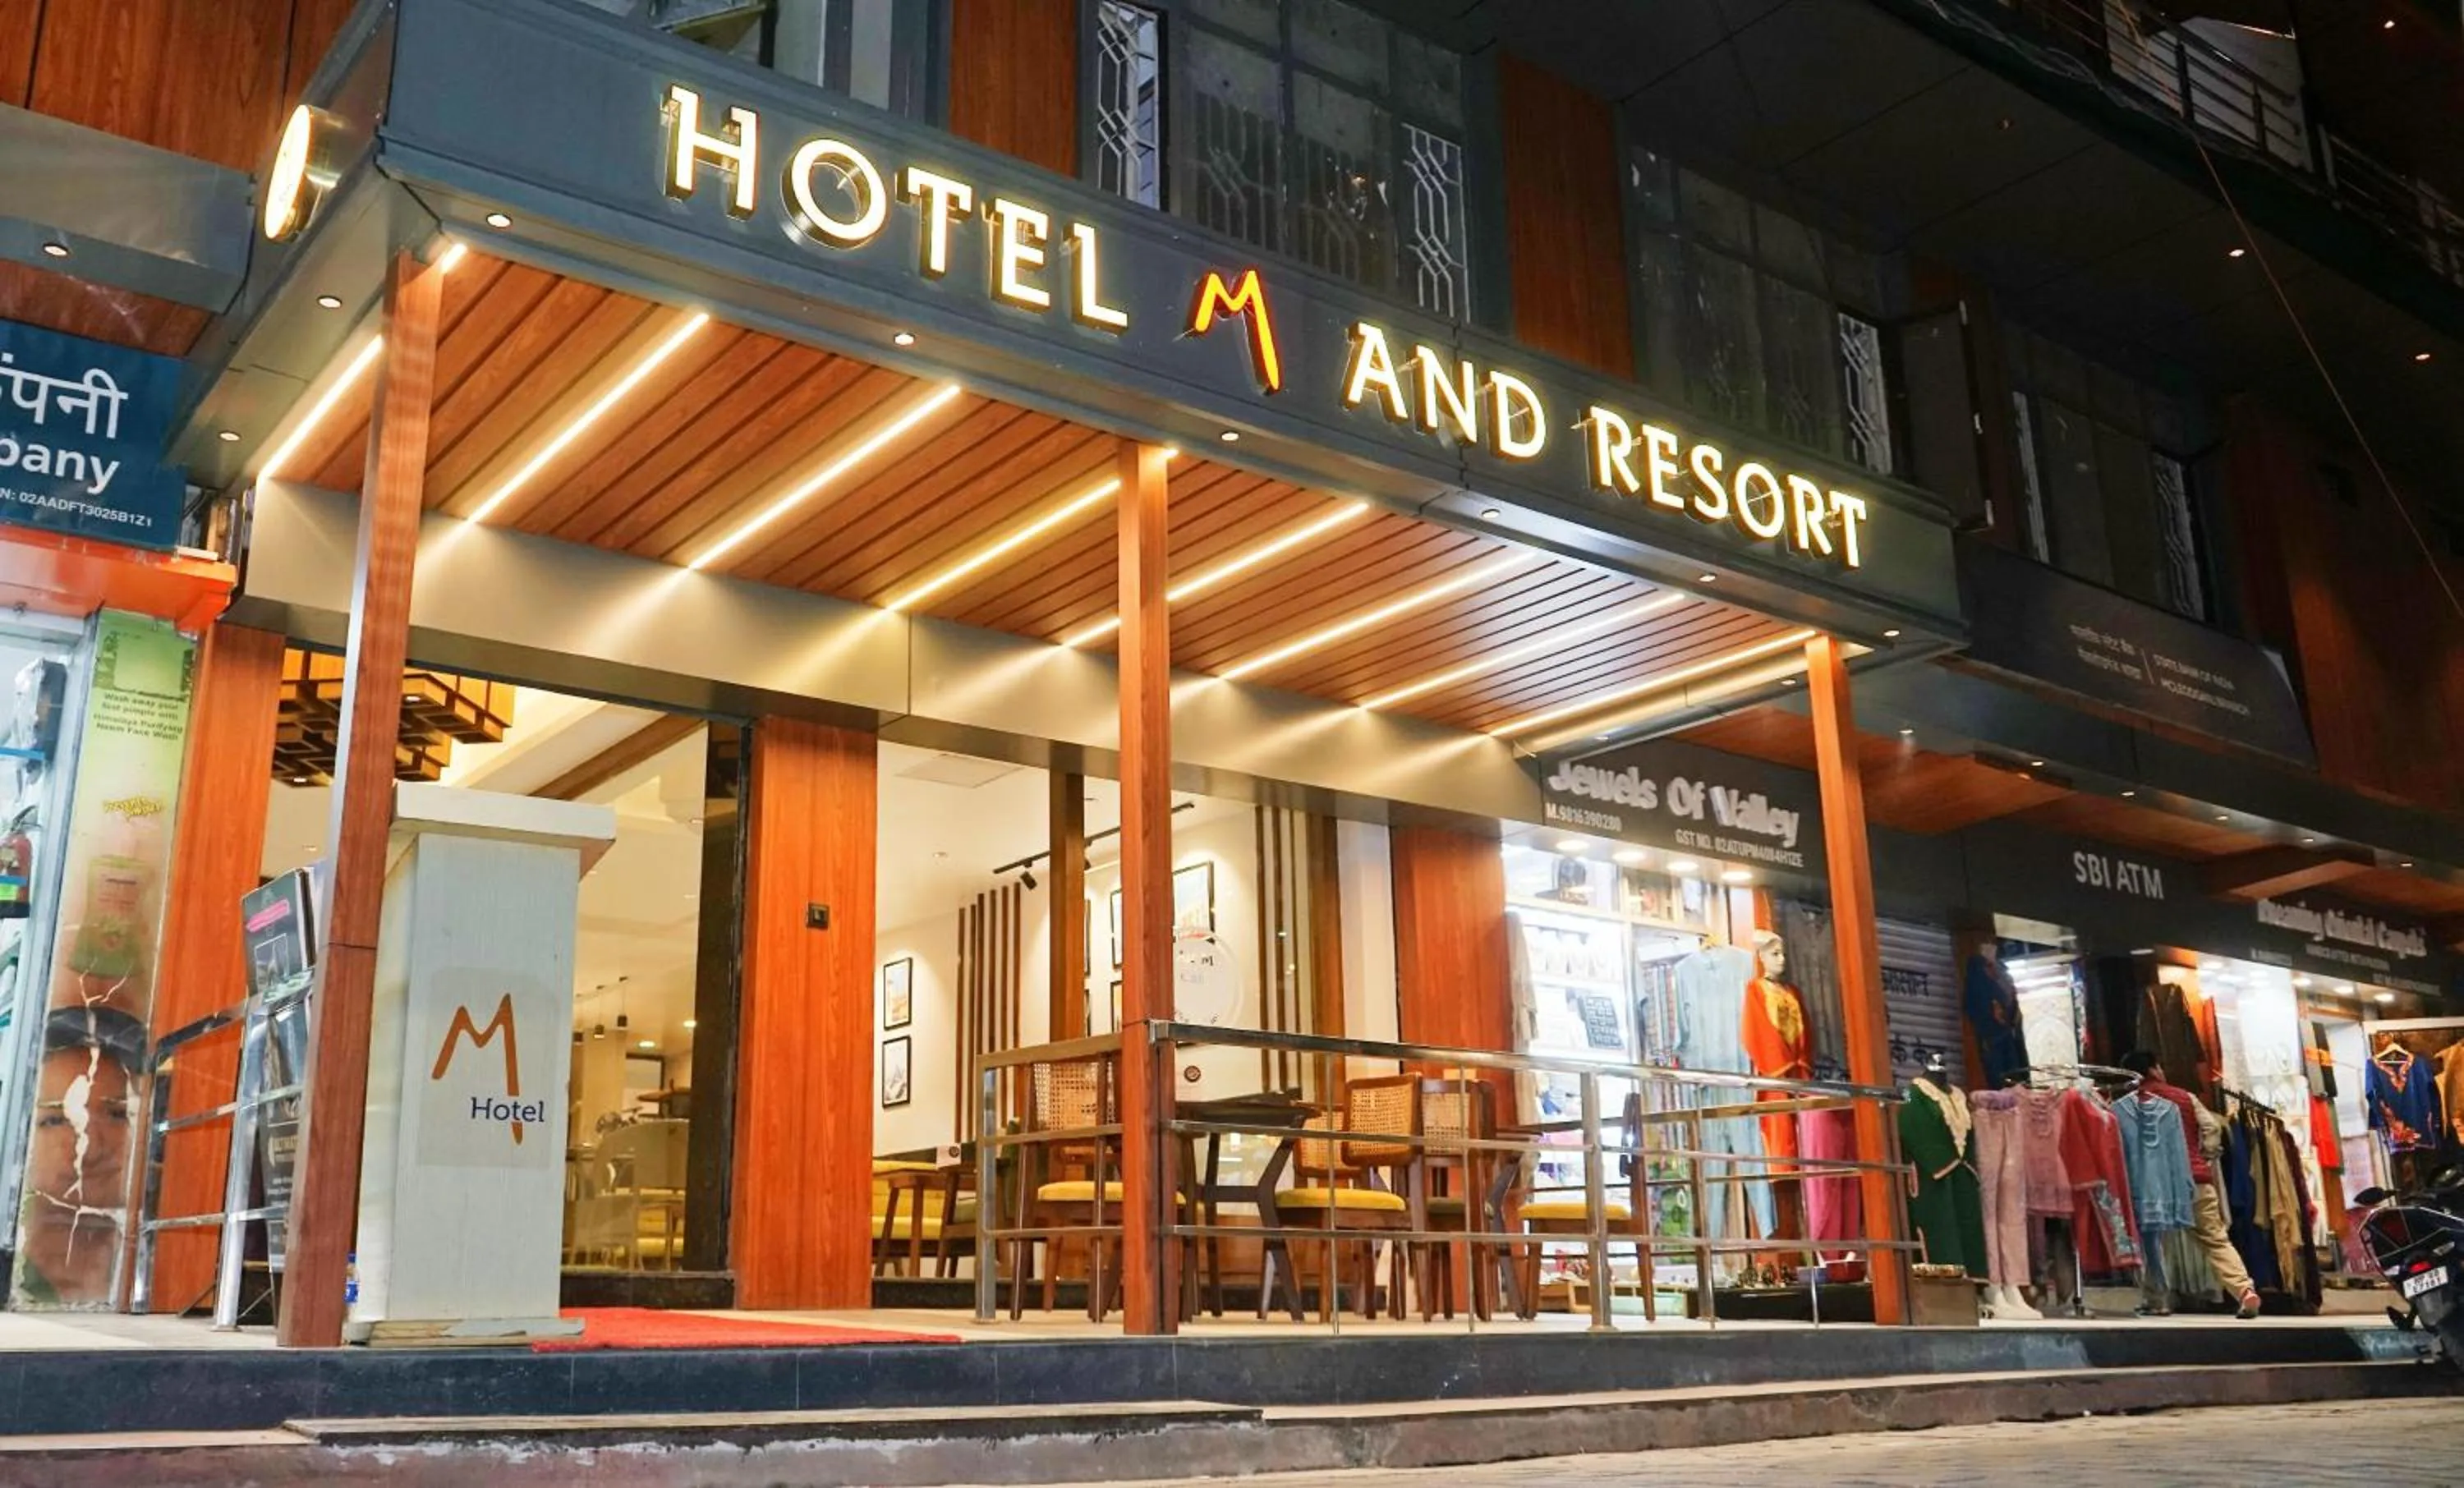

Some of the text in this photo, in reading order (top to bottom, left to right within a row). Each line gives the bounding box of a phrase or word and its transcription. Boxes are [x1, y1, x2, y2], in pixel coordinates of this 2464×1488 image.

[666, 84, 1867, 568] HOTEL M AND RESORT
[0, 351, 128, 439] ंपनी
[20, 492, 153, 526] 02AADFT3025B1Z1
[1548, 760, 1799, 847] Jewels Of Valley
[1675, 829, 1696, 847] GST
[2073, 850, 2164, 900] SBI ATM
[471, 1096, 545, 1123] Hotel
